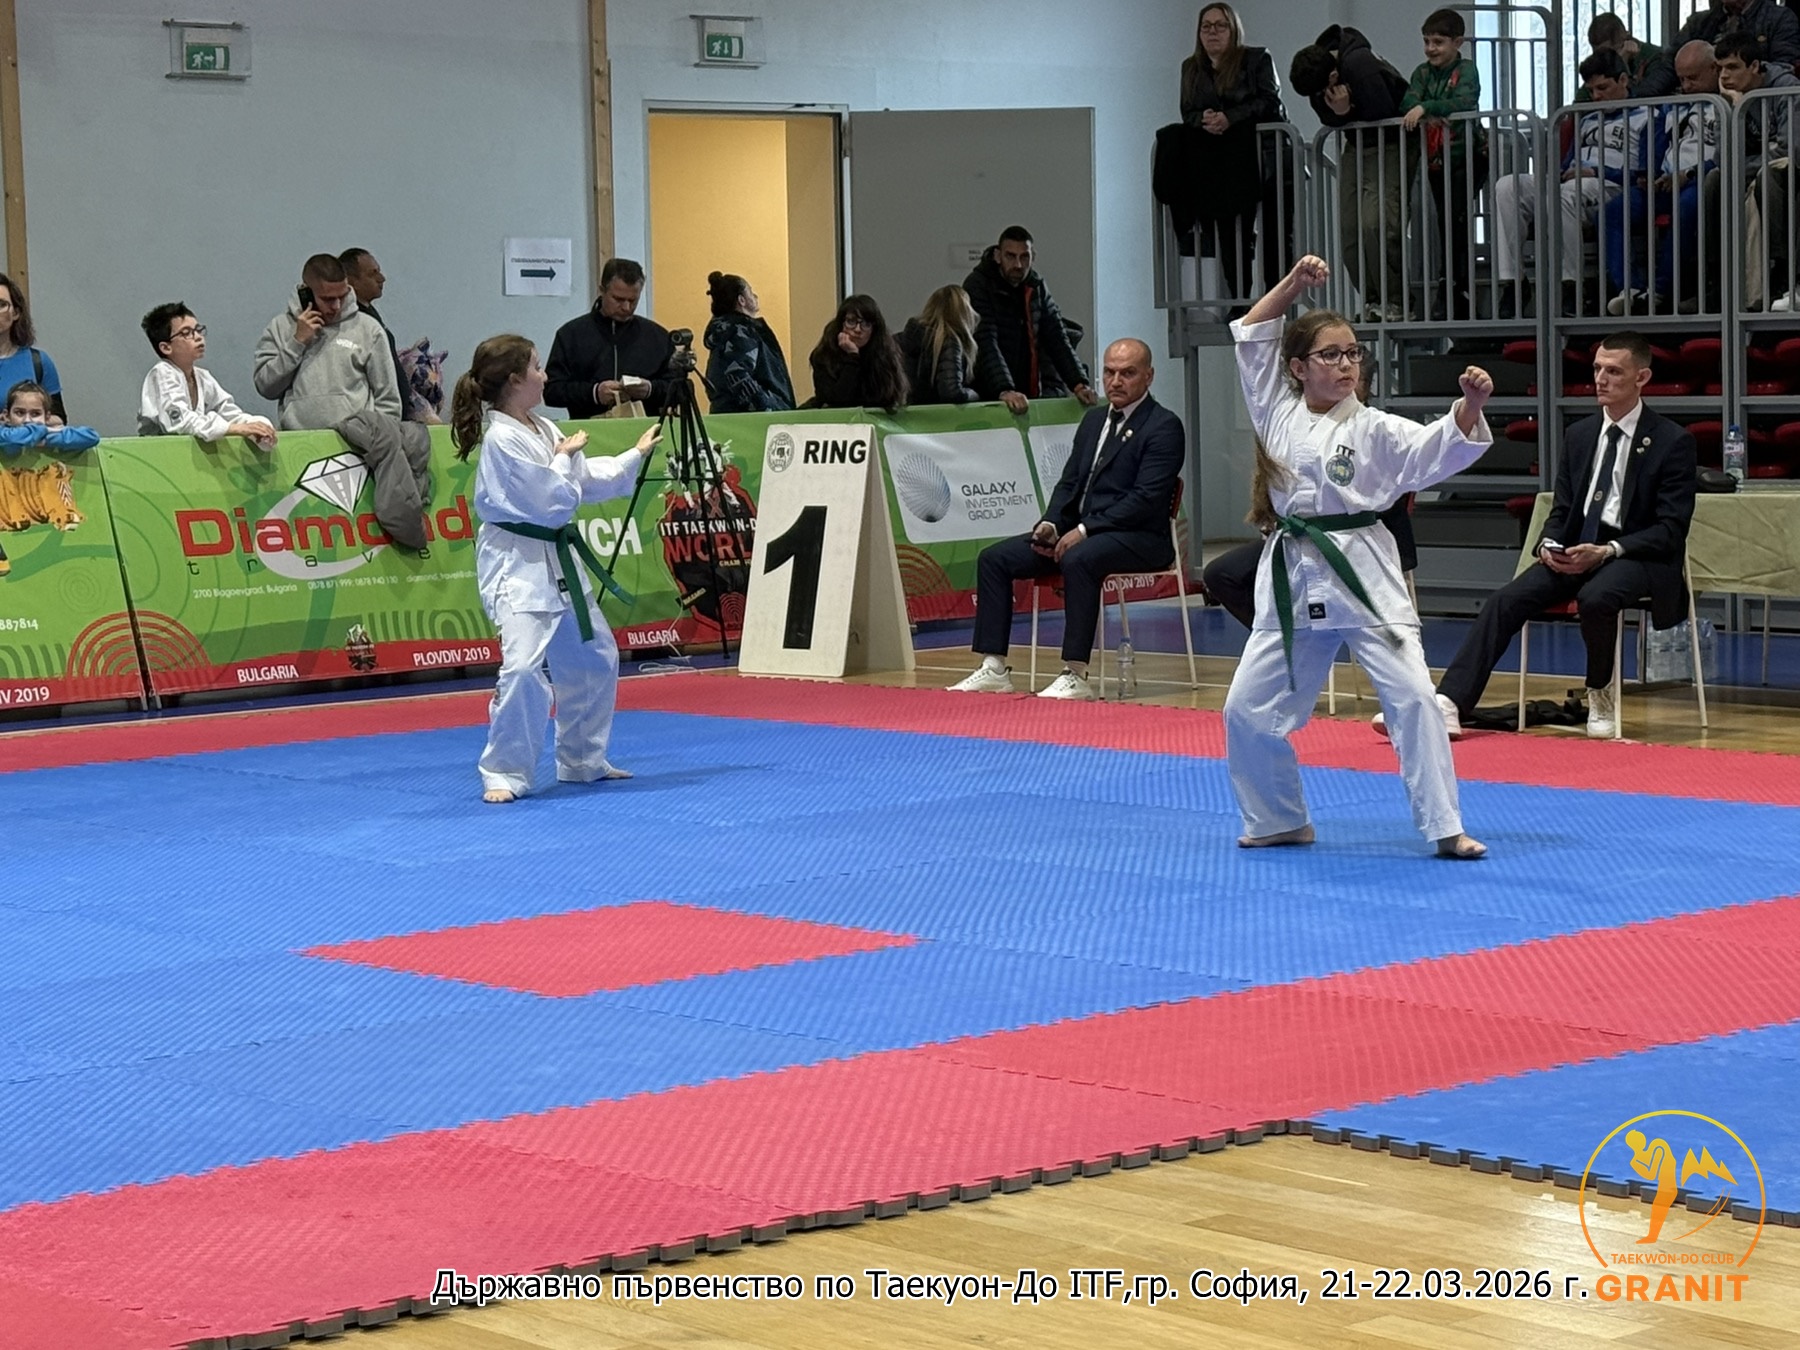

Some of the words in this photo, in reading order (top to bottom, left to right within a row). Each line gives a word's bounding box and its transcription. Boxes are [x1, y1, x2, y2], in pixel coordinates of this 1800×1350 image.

[803, 440, 867, 464] RING
[1336, 444, 1356, 460] ITF
[961, 481, 1017, 497] GALAXY
[965, 494, 1033, 509] INVESTMENT
[968, 509, 1005, 521] GROUP
[660, 521, 681, 537] ITF
[764, 505, 828, 650] 1
[1134, 575, 1155, 588] 2019
[627, 629, 681, 645] BULGARIA
[413, 648, 463, 666] PLOVDIV
[463, 646, 491, 662] 2019
[237, 664, 299, 683] BULGARIA
[14, 686, 50, 703] 2019
